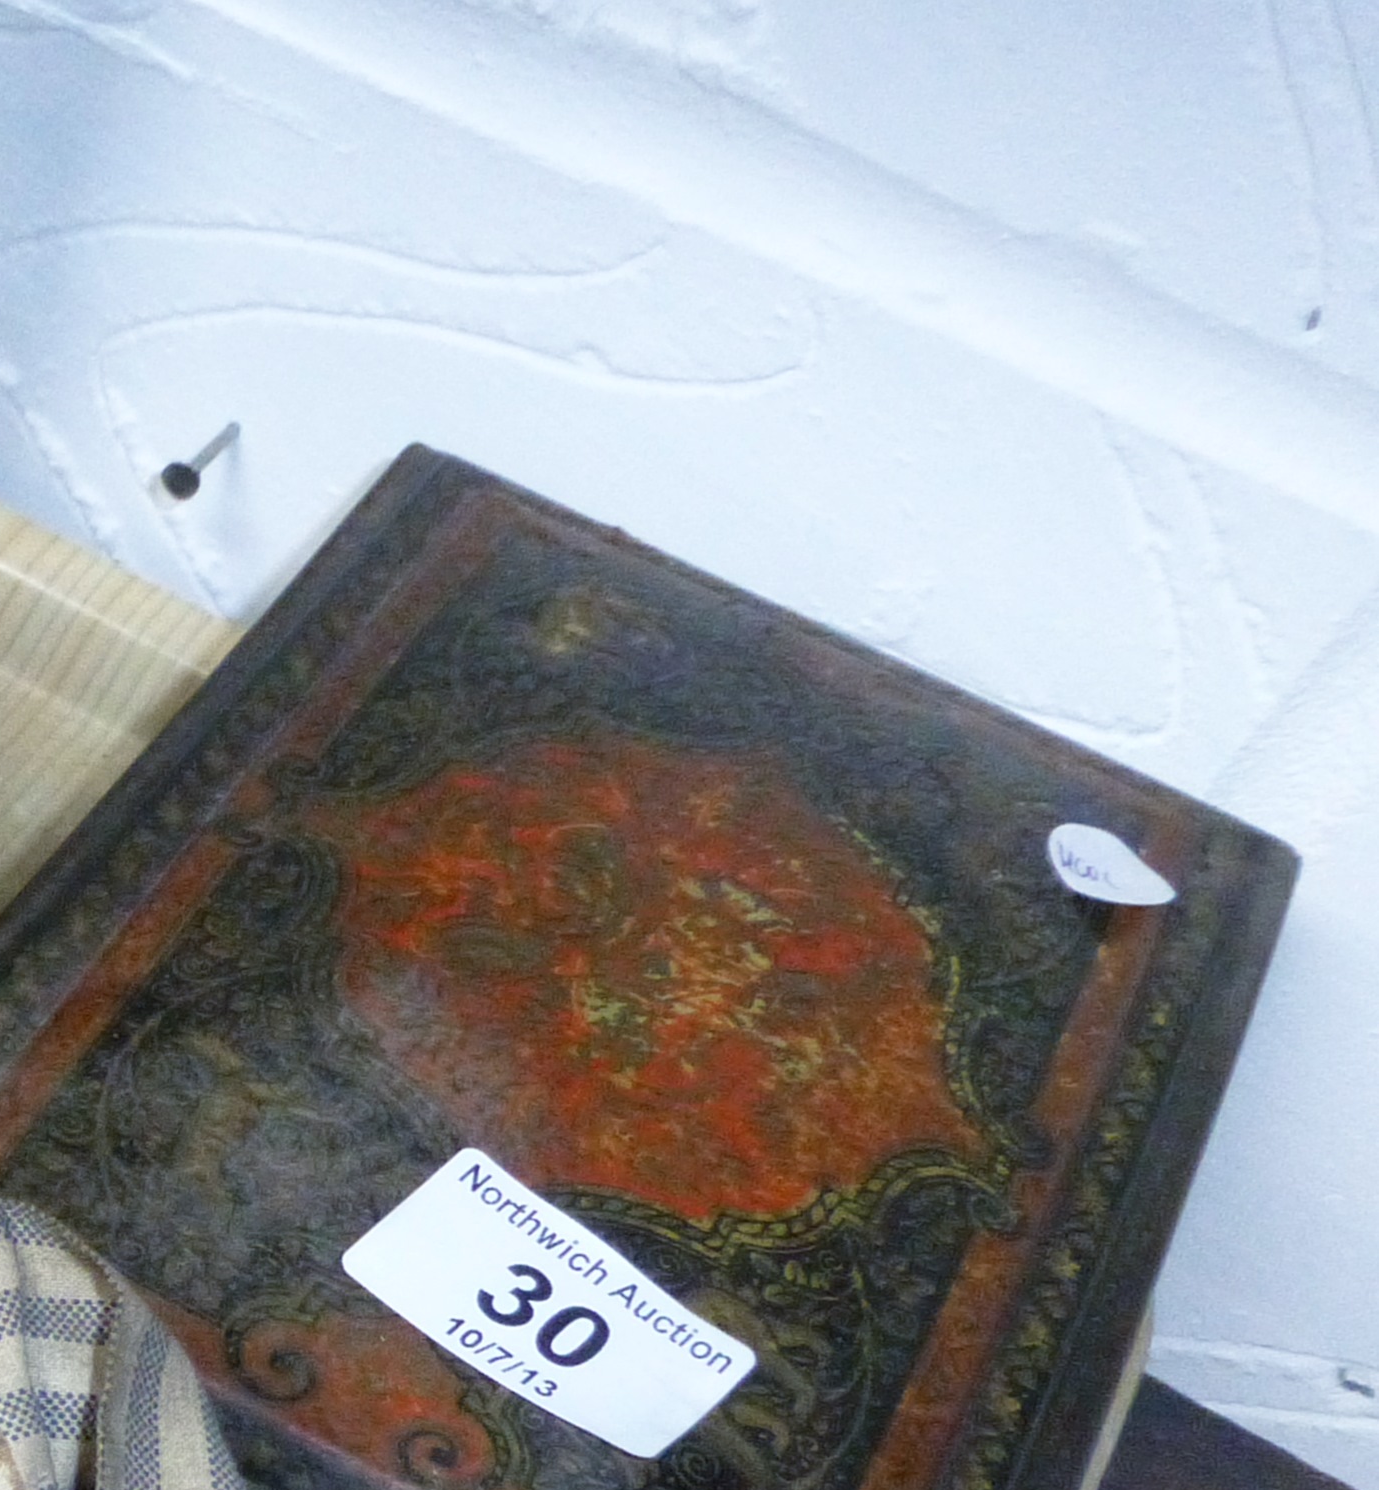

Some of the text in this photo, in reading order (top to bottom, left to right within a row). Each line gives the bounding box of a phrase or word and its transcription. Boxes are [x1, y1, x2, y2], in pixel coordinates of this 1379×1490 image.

[459, 1163, 733, 1376] Northwich Auction
[476, 1264, 610, 1368] 30
[445, 1316, 559, 1399] 10/7/13
